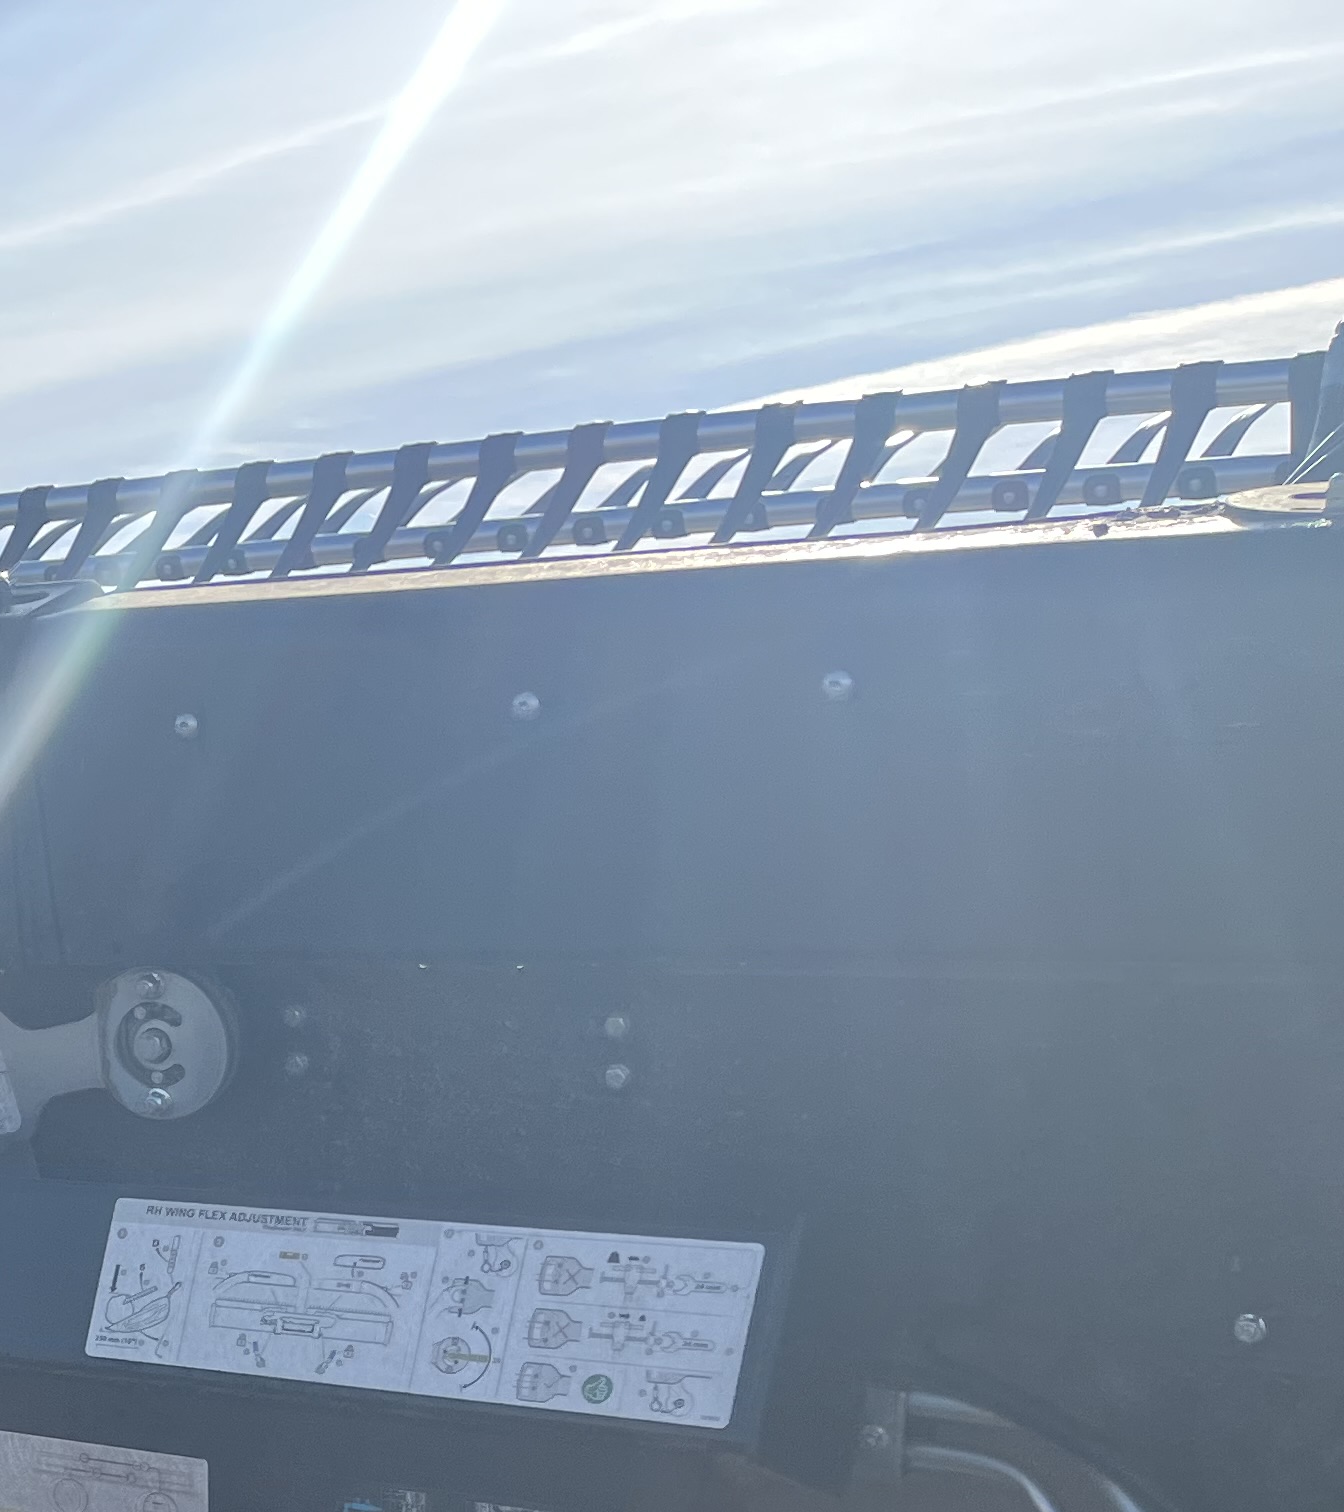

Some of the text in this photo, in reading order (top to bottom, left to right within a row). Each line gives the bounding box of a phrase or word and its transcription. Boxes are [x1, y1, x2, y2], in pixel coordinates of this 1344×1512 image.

[145, 1205, 309, 1228] RH WING FLEX ADJUSTMENT
